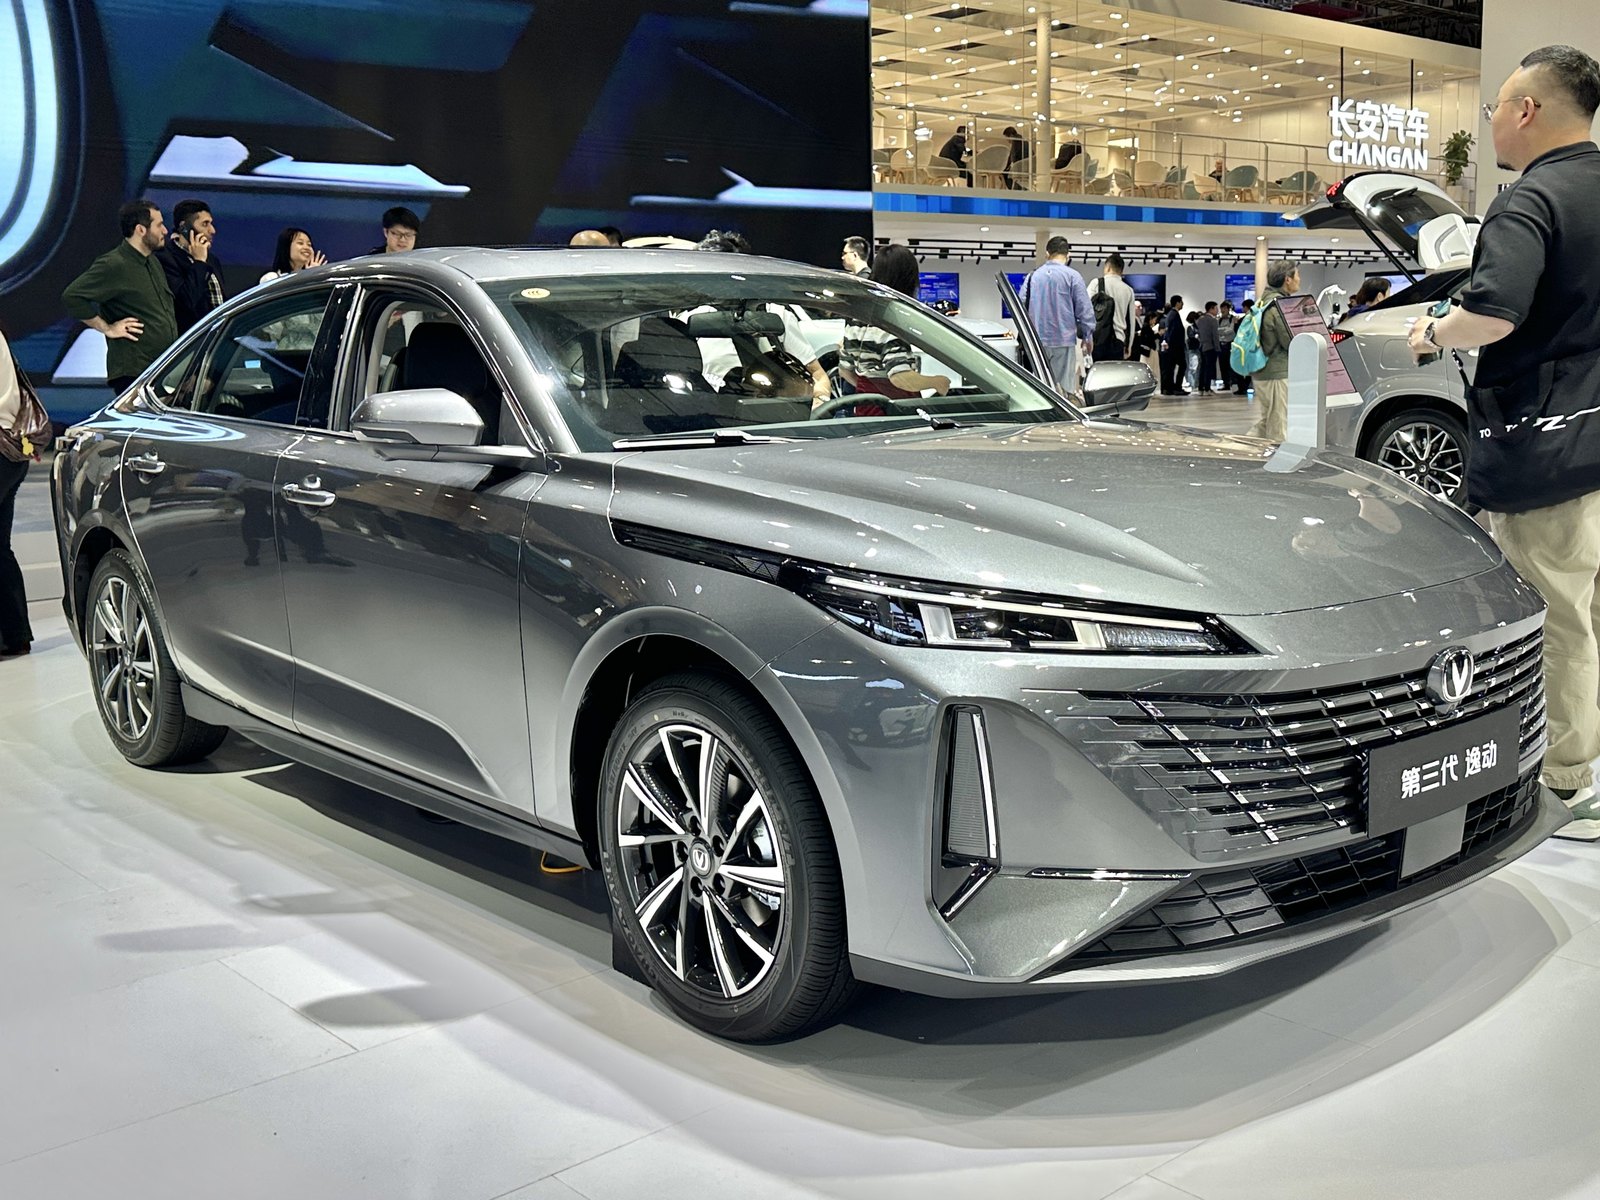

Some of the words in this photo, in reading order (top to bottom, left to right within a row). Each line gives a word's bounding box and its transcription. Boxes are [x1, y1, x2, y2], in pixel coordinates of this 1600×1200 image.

[1329, 96, 1429, 146] 长安汽车
[1328, 140, 1428, 171] CHANGAN
[1401, 754, 1458, 799] 第三代
[1465, 739, 1497, 778] 逸动
